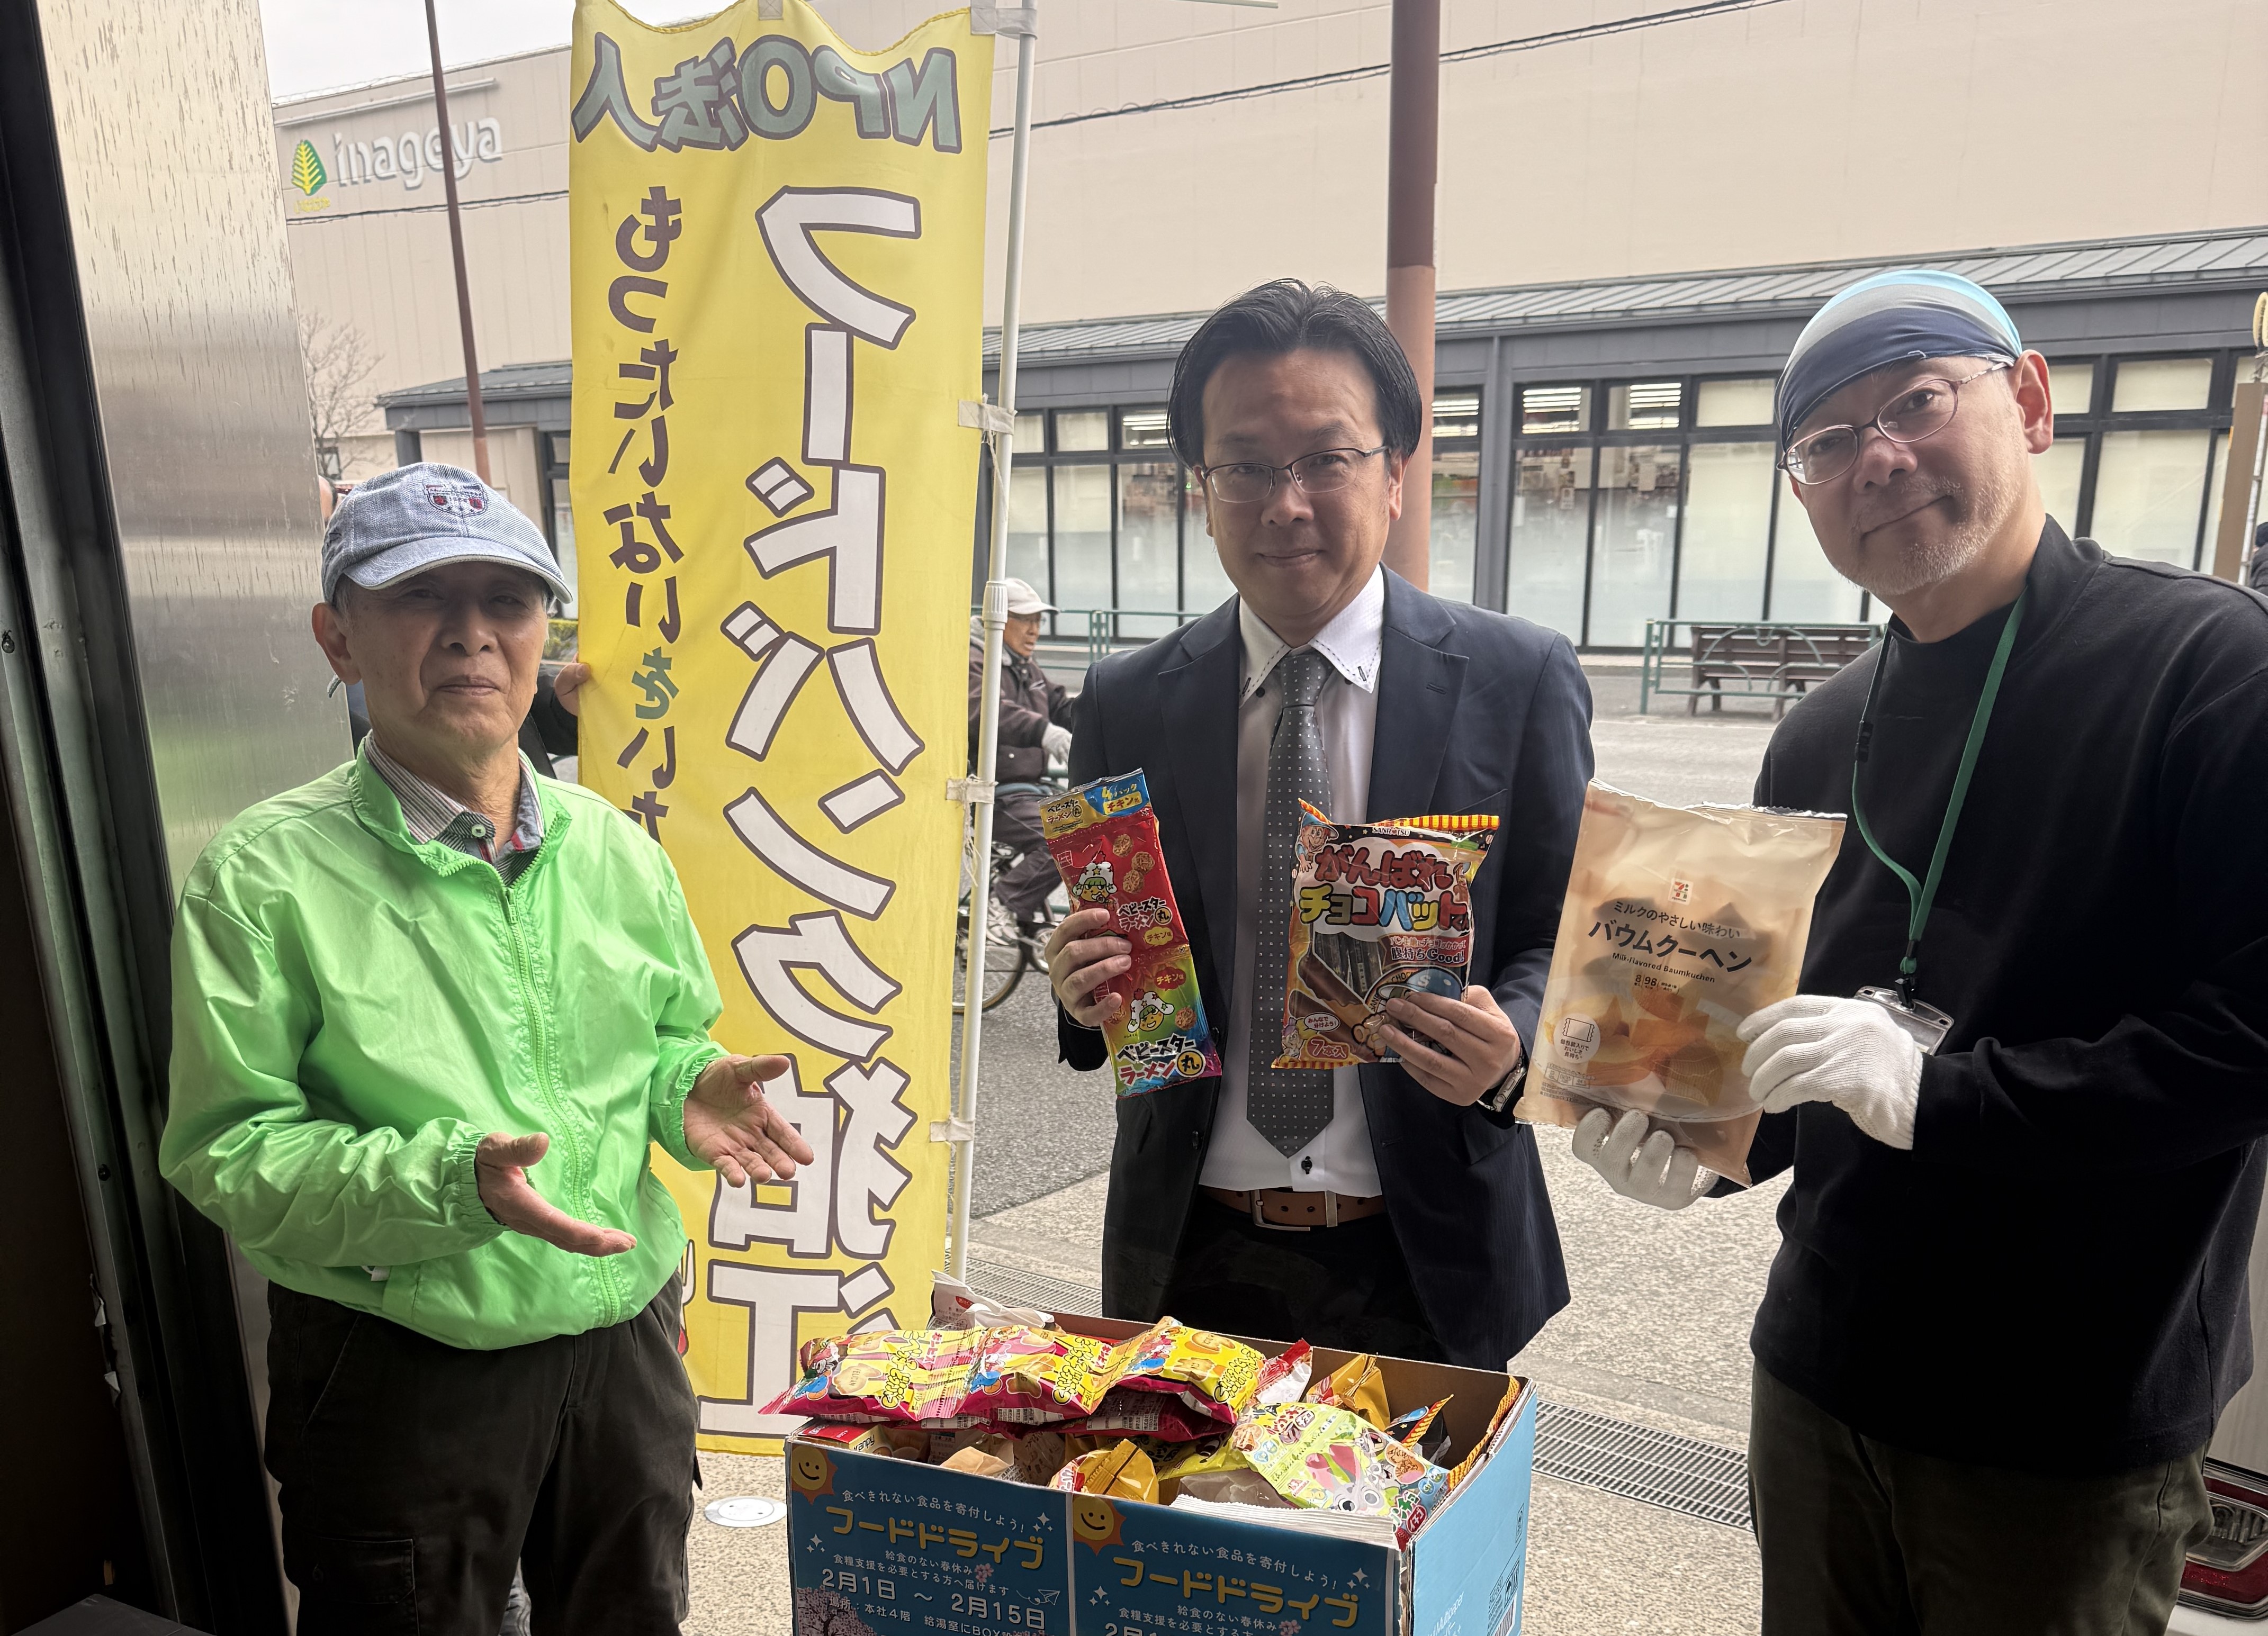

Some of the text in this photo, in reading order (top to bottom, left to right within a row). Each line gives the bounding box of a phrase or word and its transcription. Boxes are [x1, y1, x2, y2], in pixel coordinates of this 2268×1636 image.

[333, 117, 503, 191] inageya
[1047, 810, 1073, 824] ラーメン
[1048, 799, 1078, 812] ベビースター
[1314, 845, 1454, 892] がんばれ
[1118, 896, 1166, 916] ベビースター
[1614, 901, 1740, 938] ミルクのやさしい味わい
[1119, 914, 1155, 932] ラーメン
[1588, 919, 1752, 972] バウムクーヘン
[1663, 965, 1715, 983] Baumkuchen
[1117, 1034, 1195, 1061] ベビースター
[1311, 1038, 1346, 1059] 7本入
[1119, 1060, 1176, 1086] ラーメン
[825, 1506, 1044, 1569] フードドライブ
[834, 1554, 1009, 1596] 食糧支援を必要とする方へ届けます
[885, 1550, 973, 1576] 給食のない春休み
[822, 1568, 896, 1600] 2月1日
[951, 1593, 1046, 1630] 2月15日
[1113, 1557, 1358, 1627] フードドライブ
[1177, 1604, 1277, 1631] 給食のない春休み
